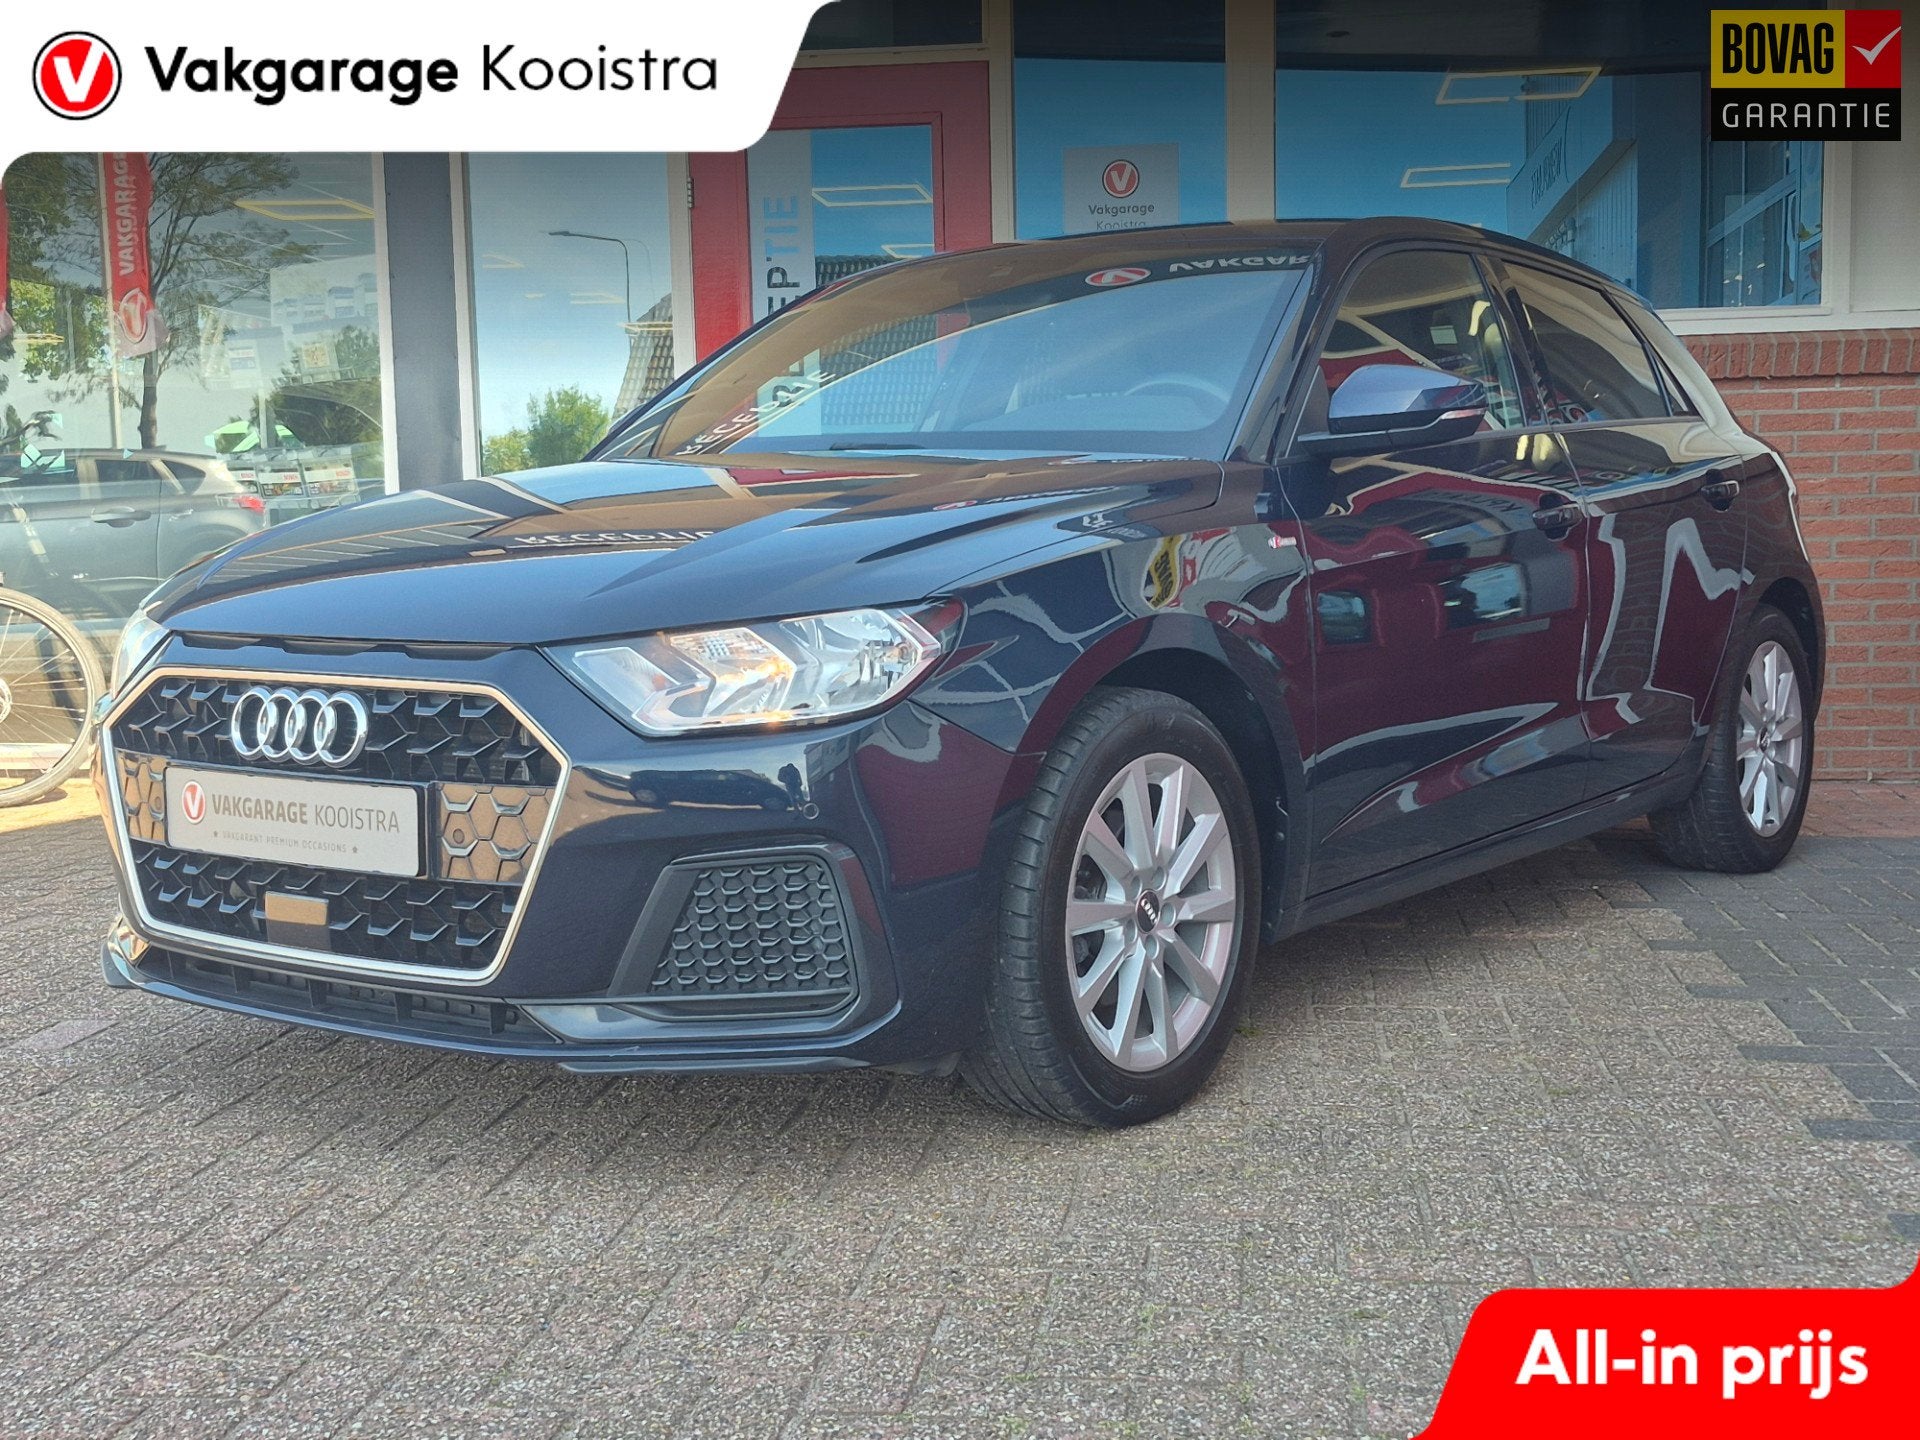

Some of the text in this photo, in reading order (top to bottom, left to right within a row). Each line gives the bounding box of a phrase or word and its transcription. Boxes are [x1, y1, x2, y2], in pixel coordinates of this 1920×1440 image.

[1088, 203, 1155, 217] Vakgarage
[211, 793, 308, 825] VAKGARAGE
[314, 804, 400, 833] KOOISTRA
[222, 831, 347, 853] VAKGARANT PREMIUM OCCASIONS
